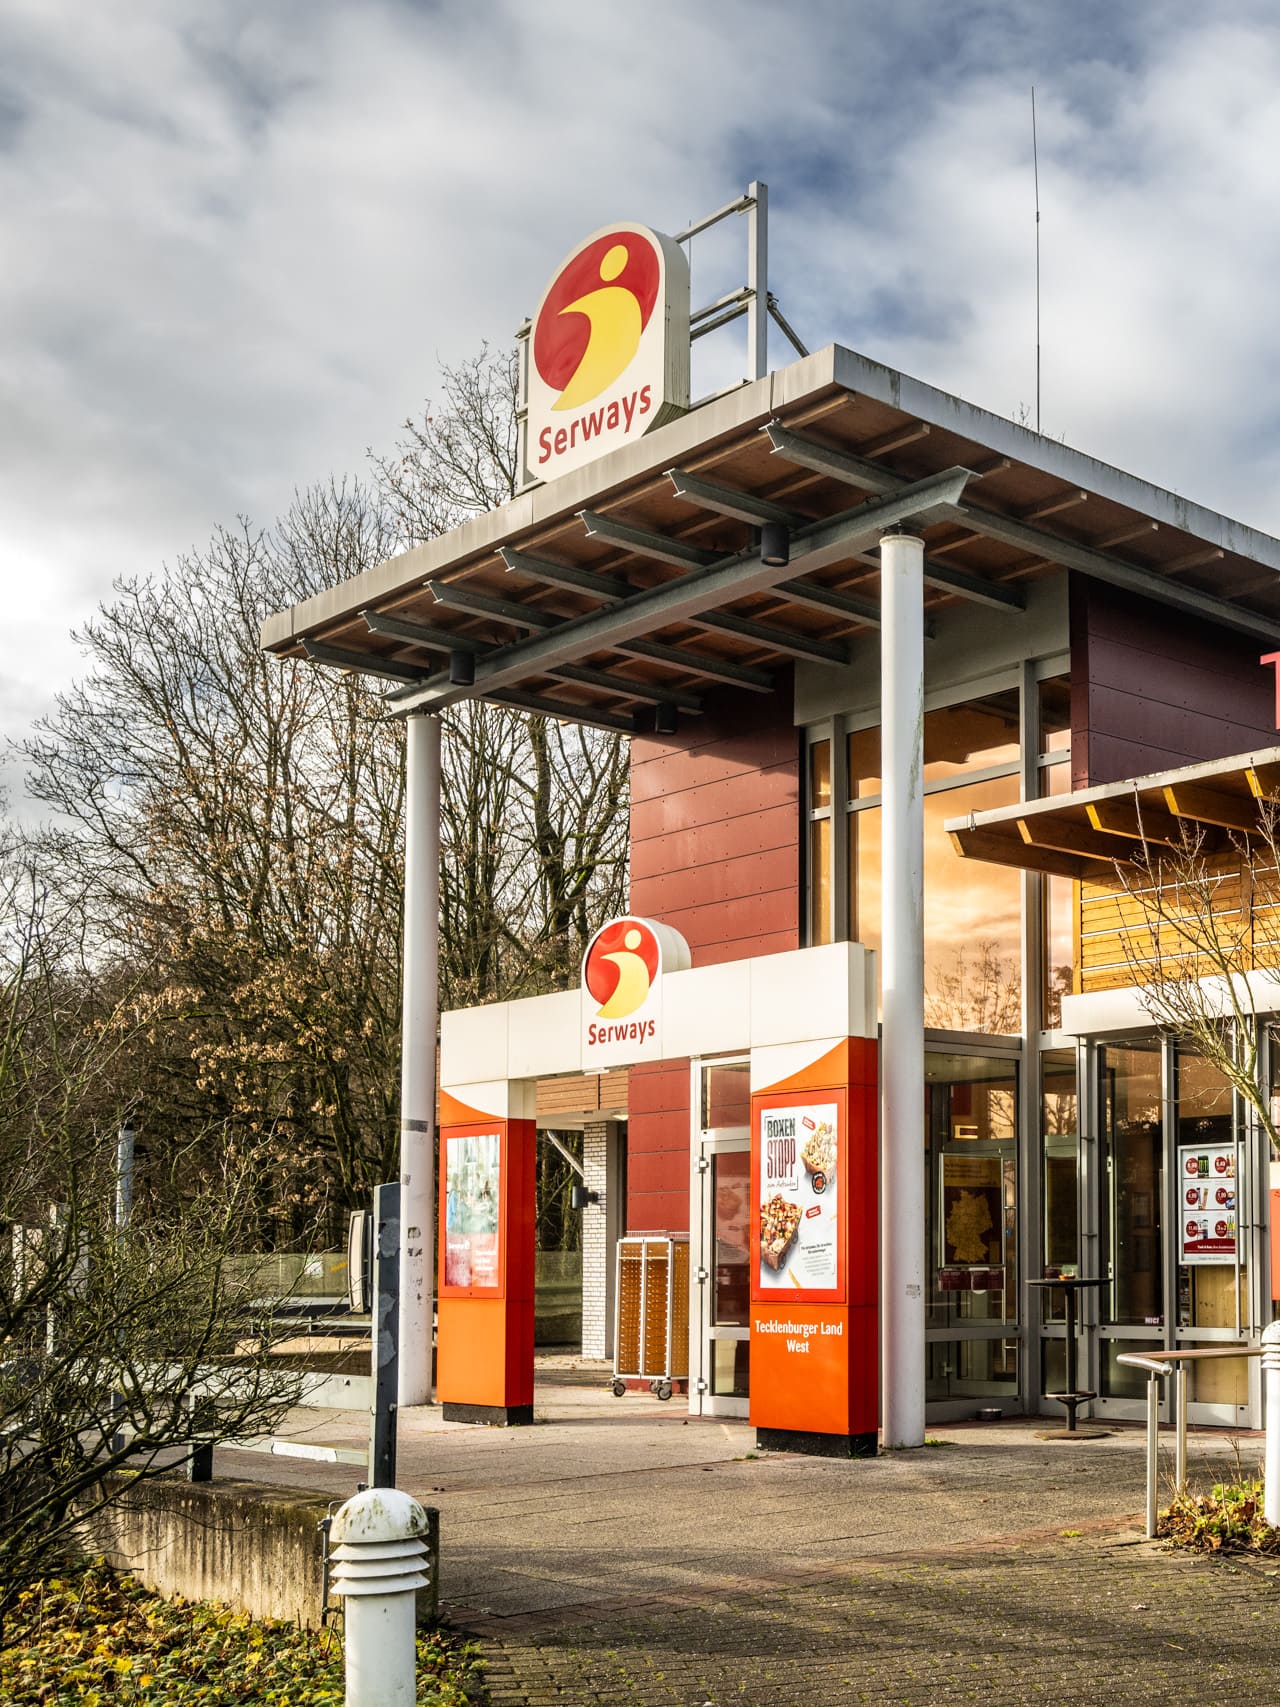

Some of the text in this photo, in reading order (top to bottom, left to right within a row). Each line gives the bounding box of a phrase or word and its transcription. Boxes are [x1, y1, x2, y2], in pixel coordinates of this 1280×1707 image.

[538, 384, 651, 464] Serways
[588, 1019, 656, 1046] Serways
[767, 1118, 796, 1138] BOXEN
[767, 1138, 796, 1179] STOPP
[755, 1320, 843, 1338] Tecklenburger Land
[786, 1339, 810, 1353] West
